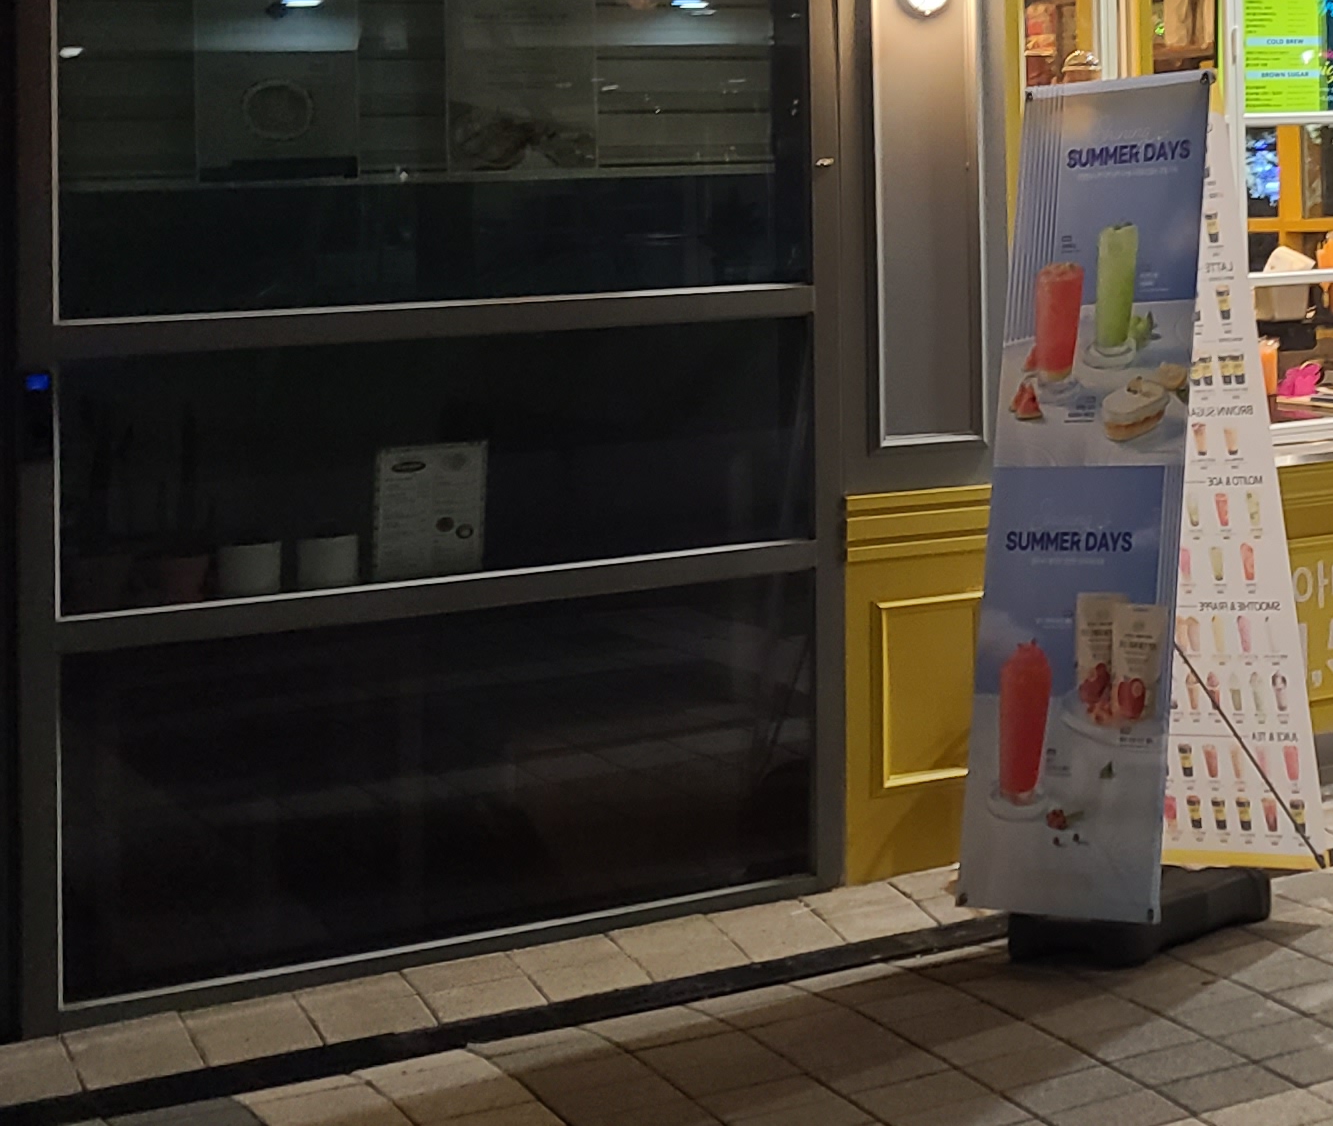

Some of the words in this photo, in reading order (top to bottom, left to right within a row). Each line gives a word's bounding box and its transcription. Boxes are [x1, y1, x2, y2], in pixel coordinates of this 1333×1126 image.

[1066, 144, 1140, 169] SUMMER
[1143, 139, 1192, 163] DAYS
[1005, 530, 1081, 552] SUMMER
[1084, 530, 1133, 553] DAYS
